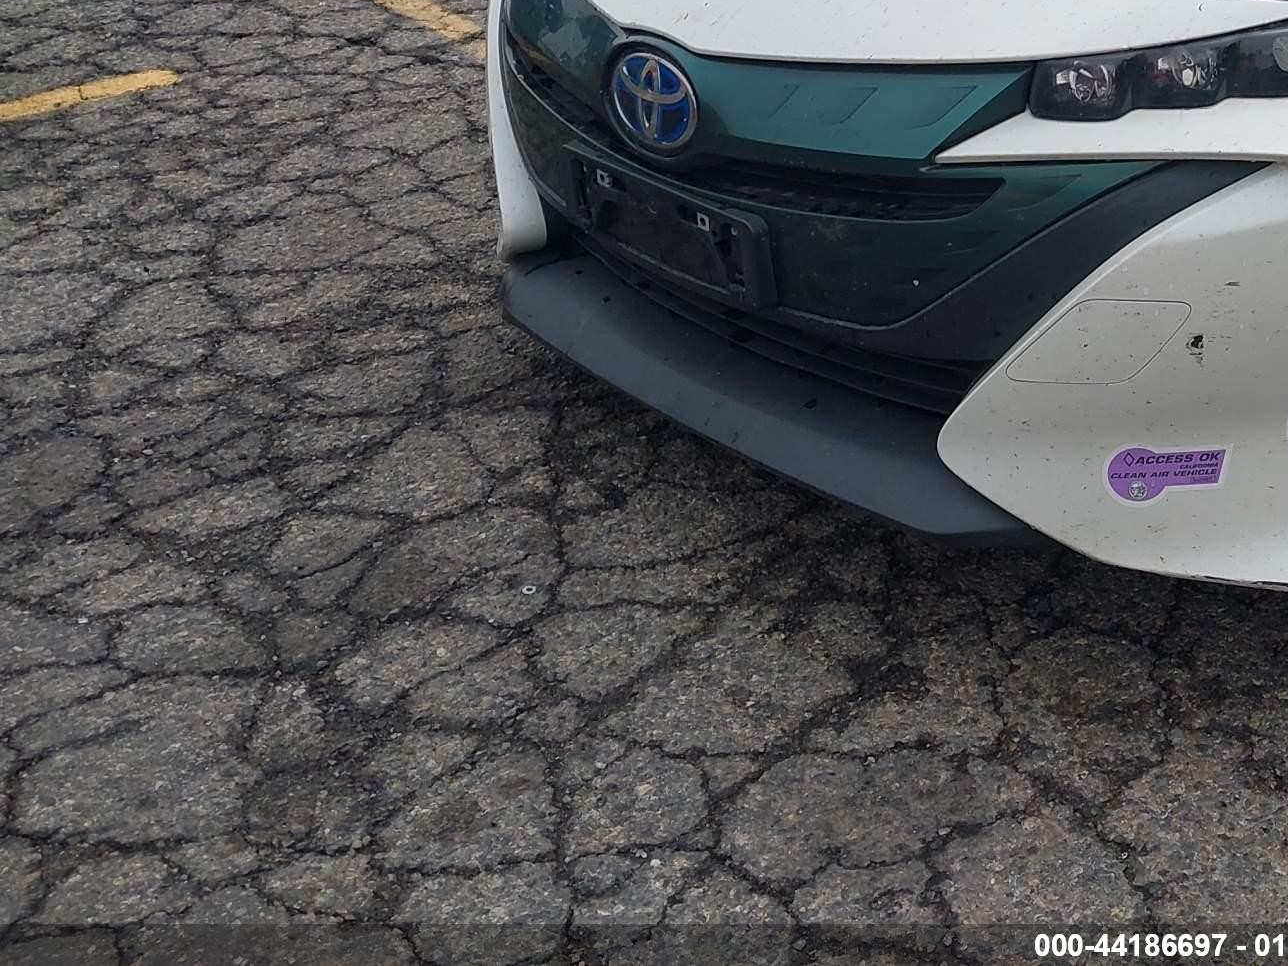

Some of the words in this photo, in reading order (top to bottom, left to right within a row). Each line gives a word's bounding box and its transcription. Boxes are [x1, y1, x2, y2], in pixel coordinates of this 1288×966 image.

[1134, 454, 1194, 465] ACCESS
[1199, 452, 1221, 462] OK
[1179, 462, 1219, 470] CALIFORNIA
[1110, 472, 1147, 480] CLEAN
[1173, 468, 1217, 477] VEHICLE
